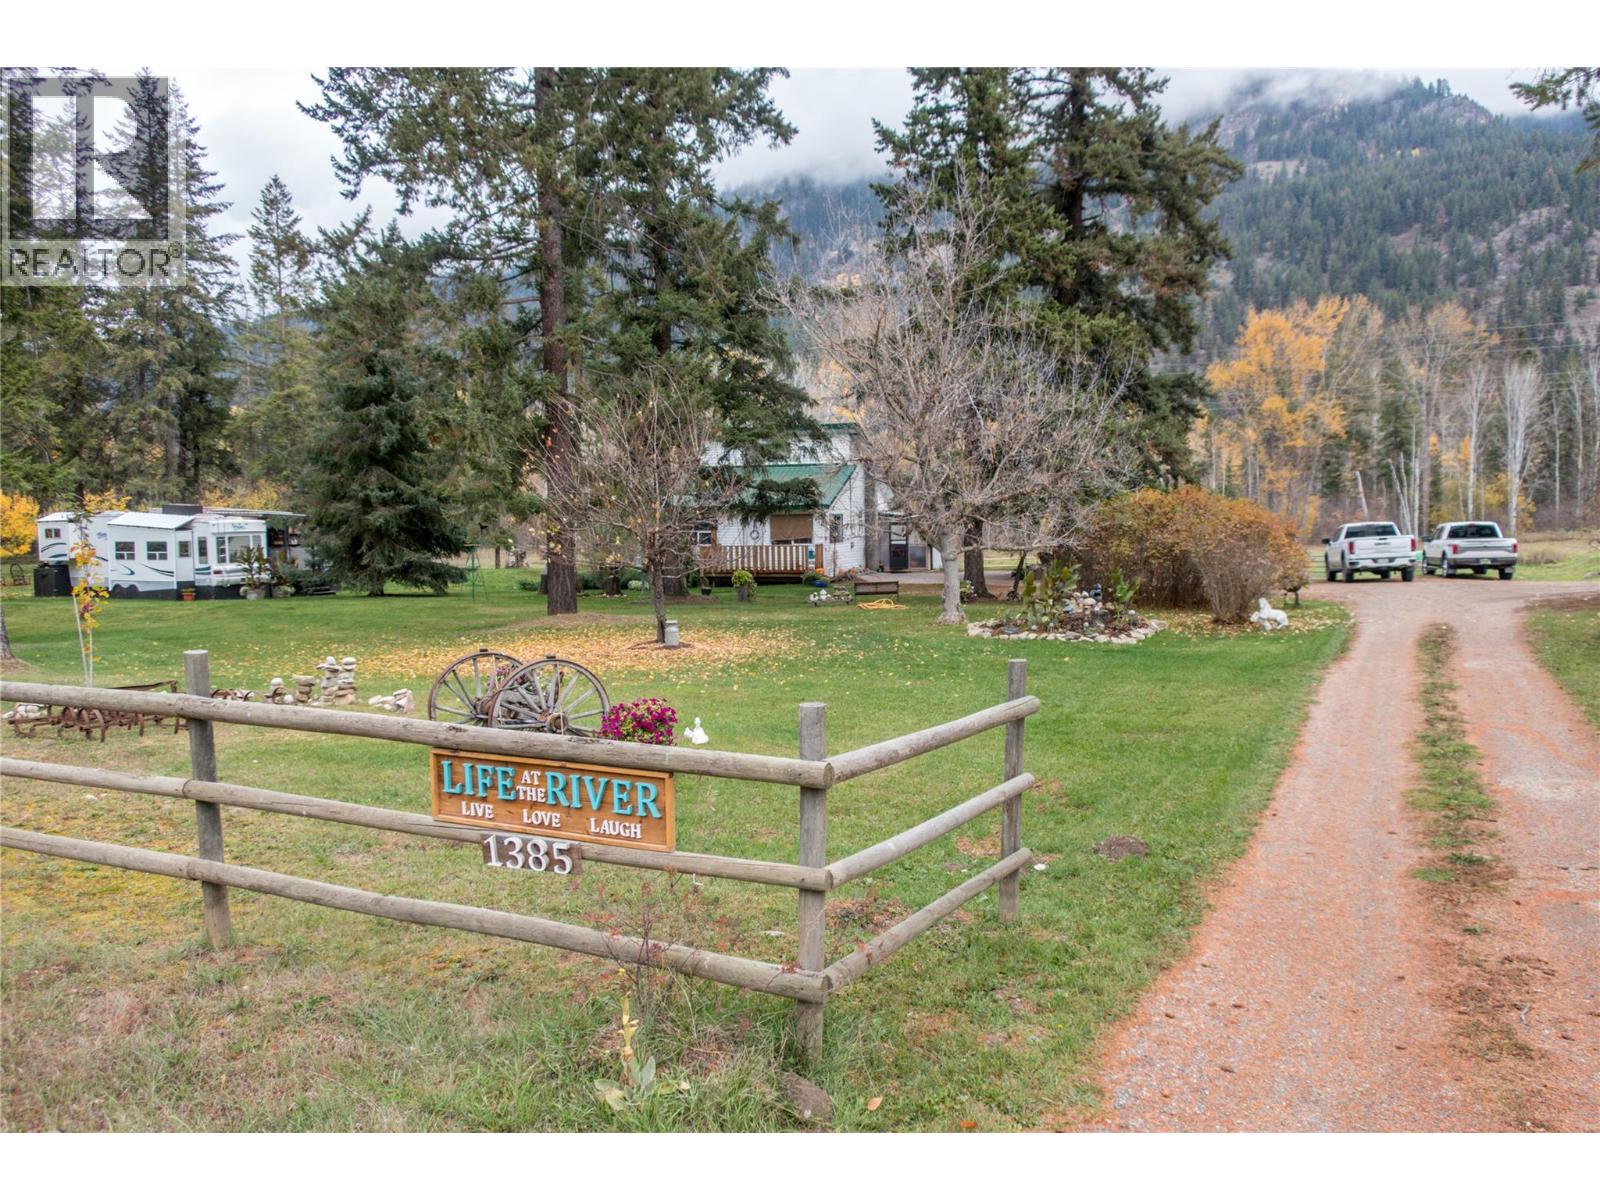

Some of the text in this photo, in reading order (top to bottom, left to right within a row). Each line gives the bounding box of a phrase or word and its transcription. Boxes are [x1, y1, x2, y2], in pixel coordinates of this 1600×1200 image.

[441, 760, 662, 818] LIFE AT THE RIVER
[461, 801, 642, 839] LIVE LOVE LAUGH
[483, 834, 573, 875] 1385
